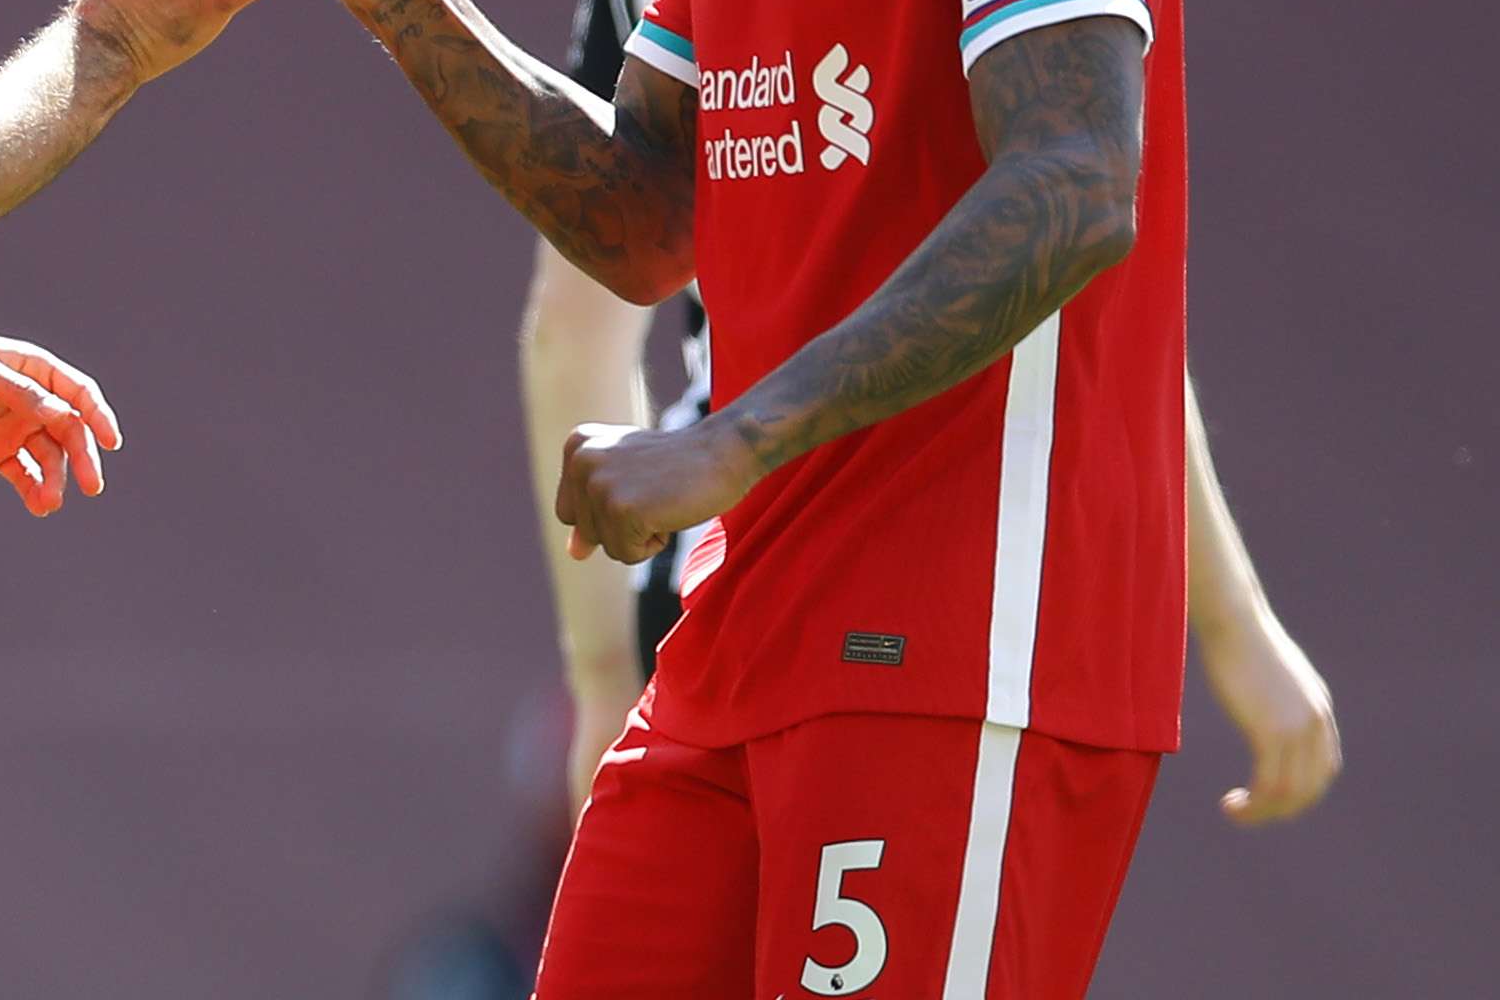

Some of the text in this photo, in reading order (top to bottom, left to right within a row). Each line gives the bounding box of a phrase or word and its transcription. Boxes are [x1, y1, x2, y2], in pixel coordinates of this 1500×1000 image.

[696, 50, 795, 111] andard
[705, 120, 804, 180] artered
[800, 839, 888, 996] 5
